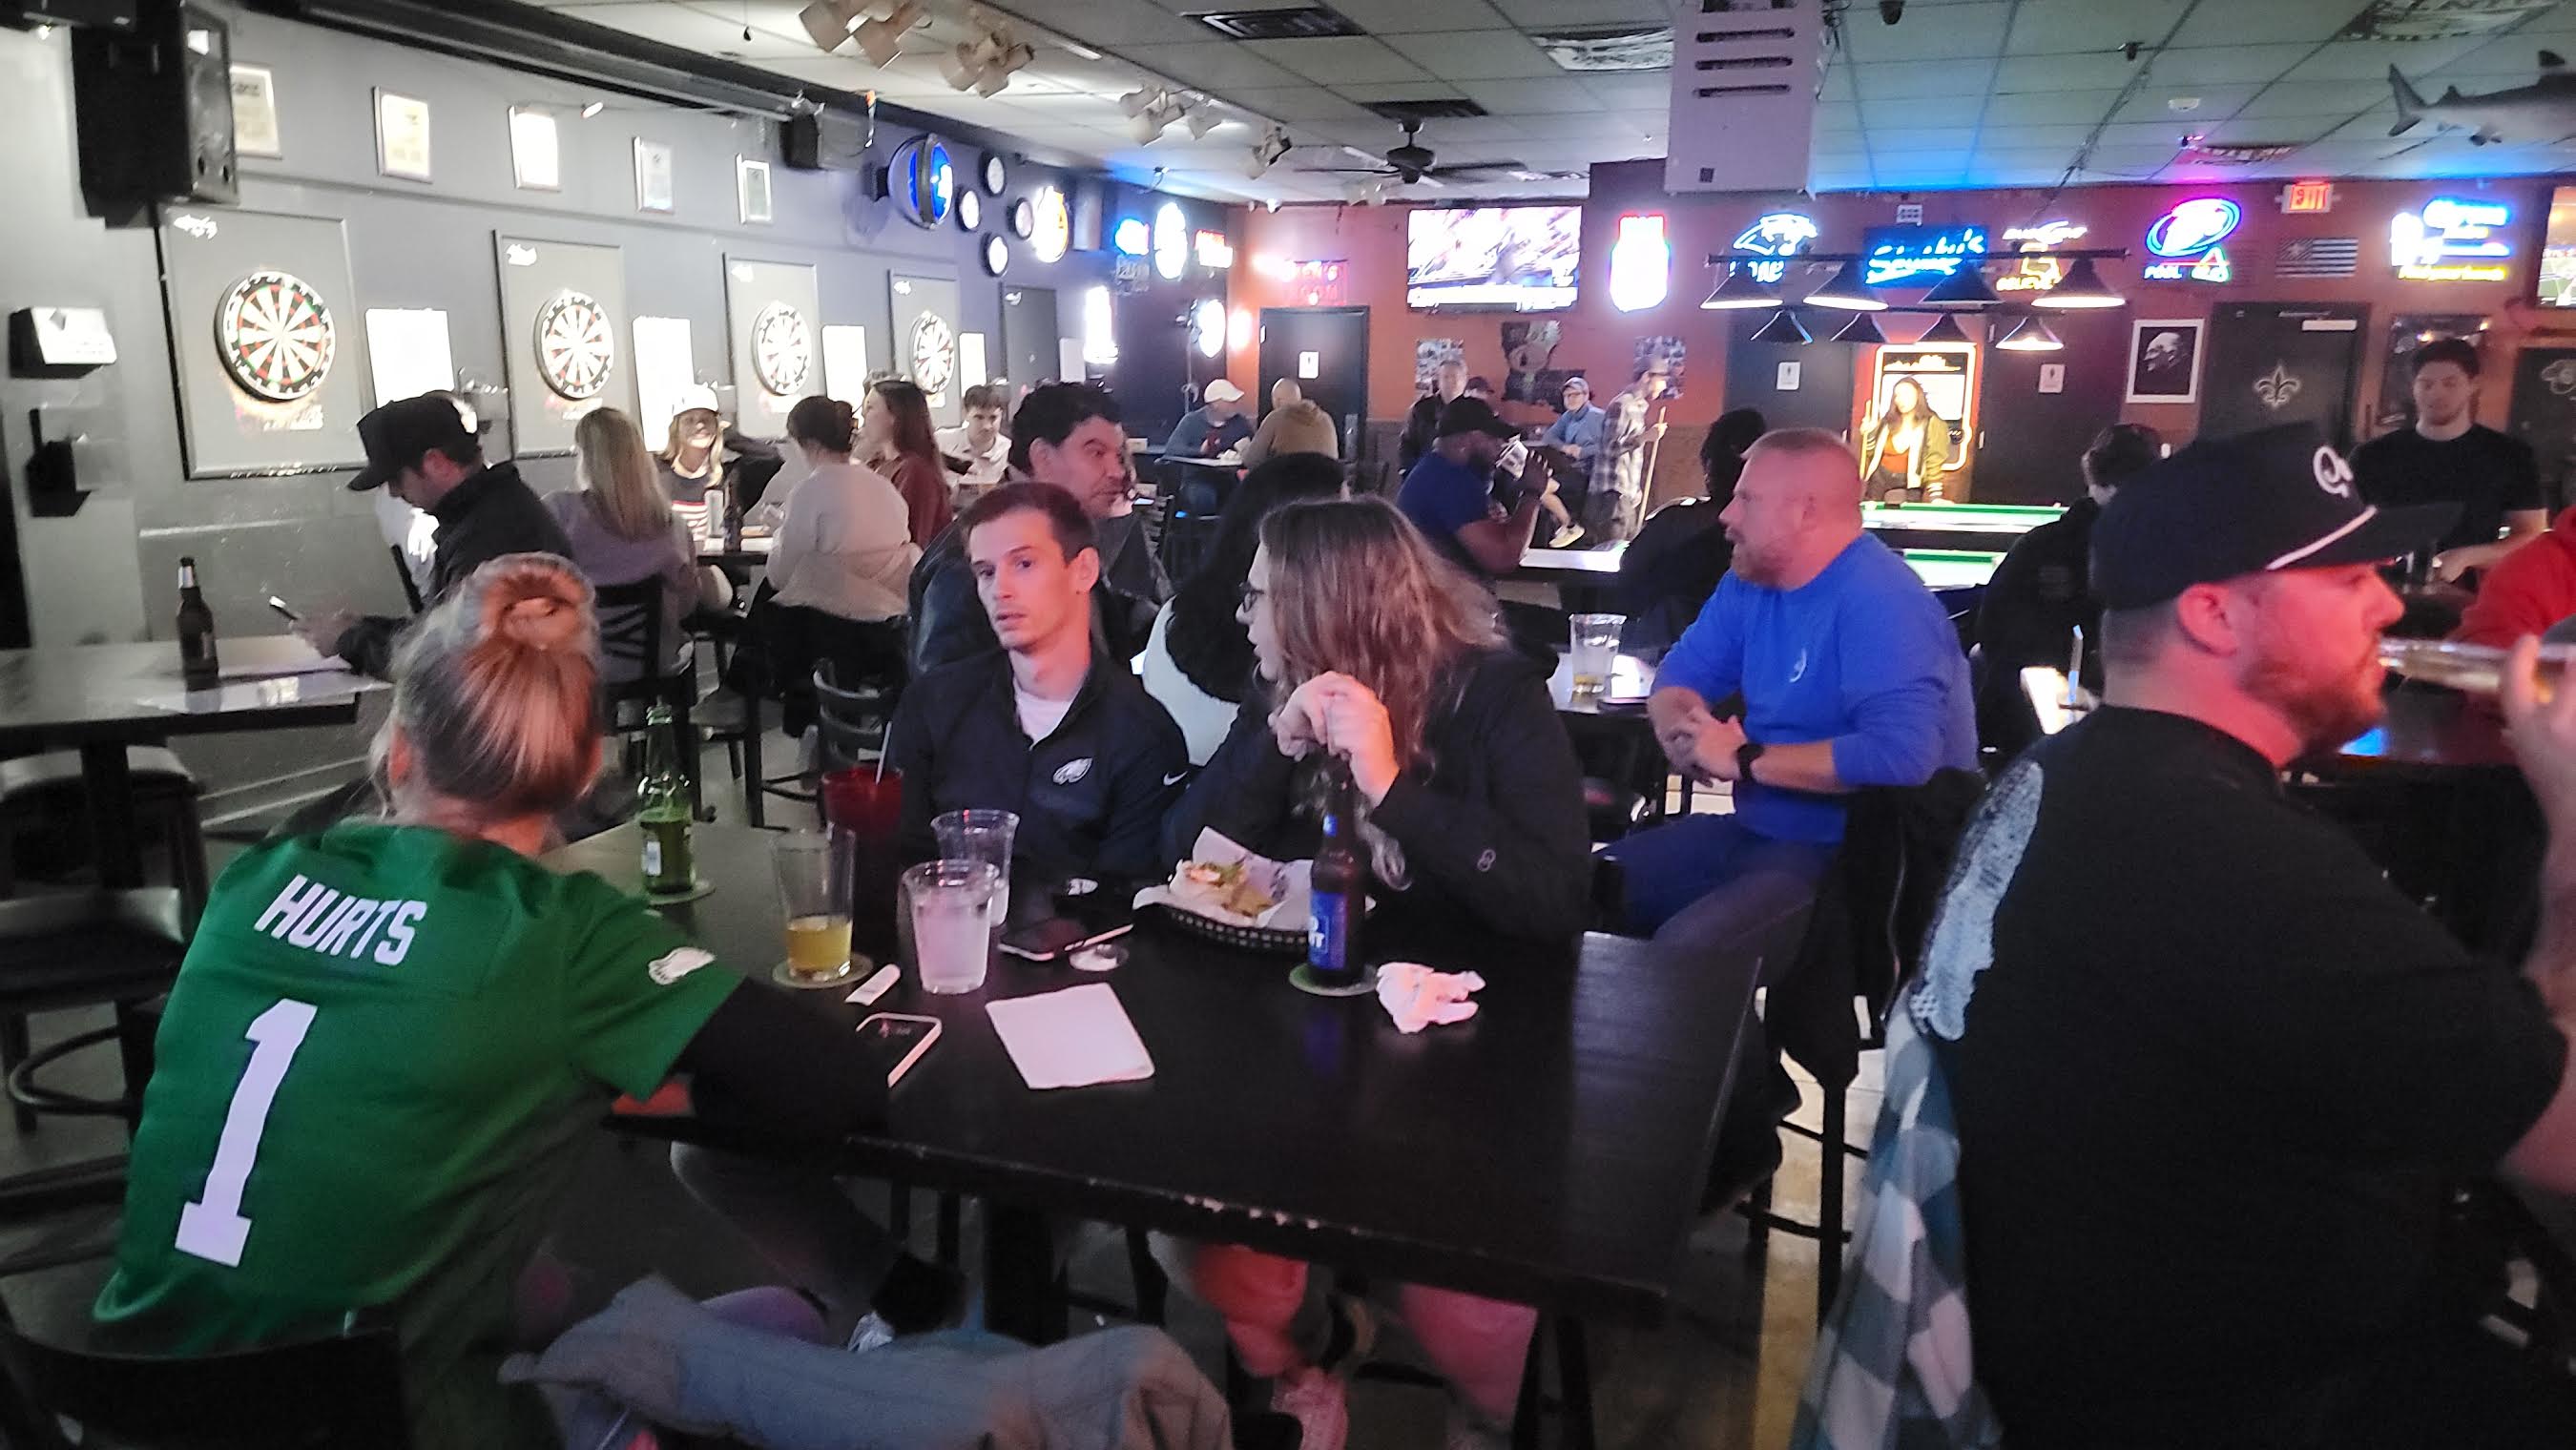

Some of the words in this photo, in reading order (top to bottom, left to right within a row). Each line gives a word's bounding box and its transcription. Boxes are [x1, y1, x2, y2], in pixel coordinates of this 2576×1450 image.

[2291, 185, 2329, 210] EXIT
[254, 874, 427, 966] HURTS
[175, 998, 319, 1269] 1
